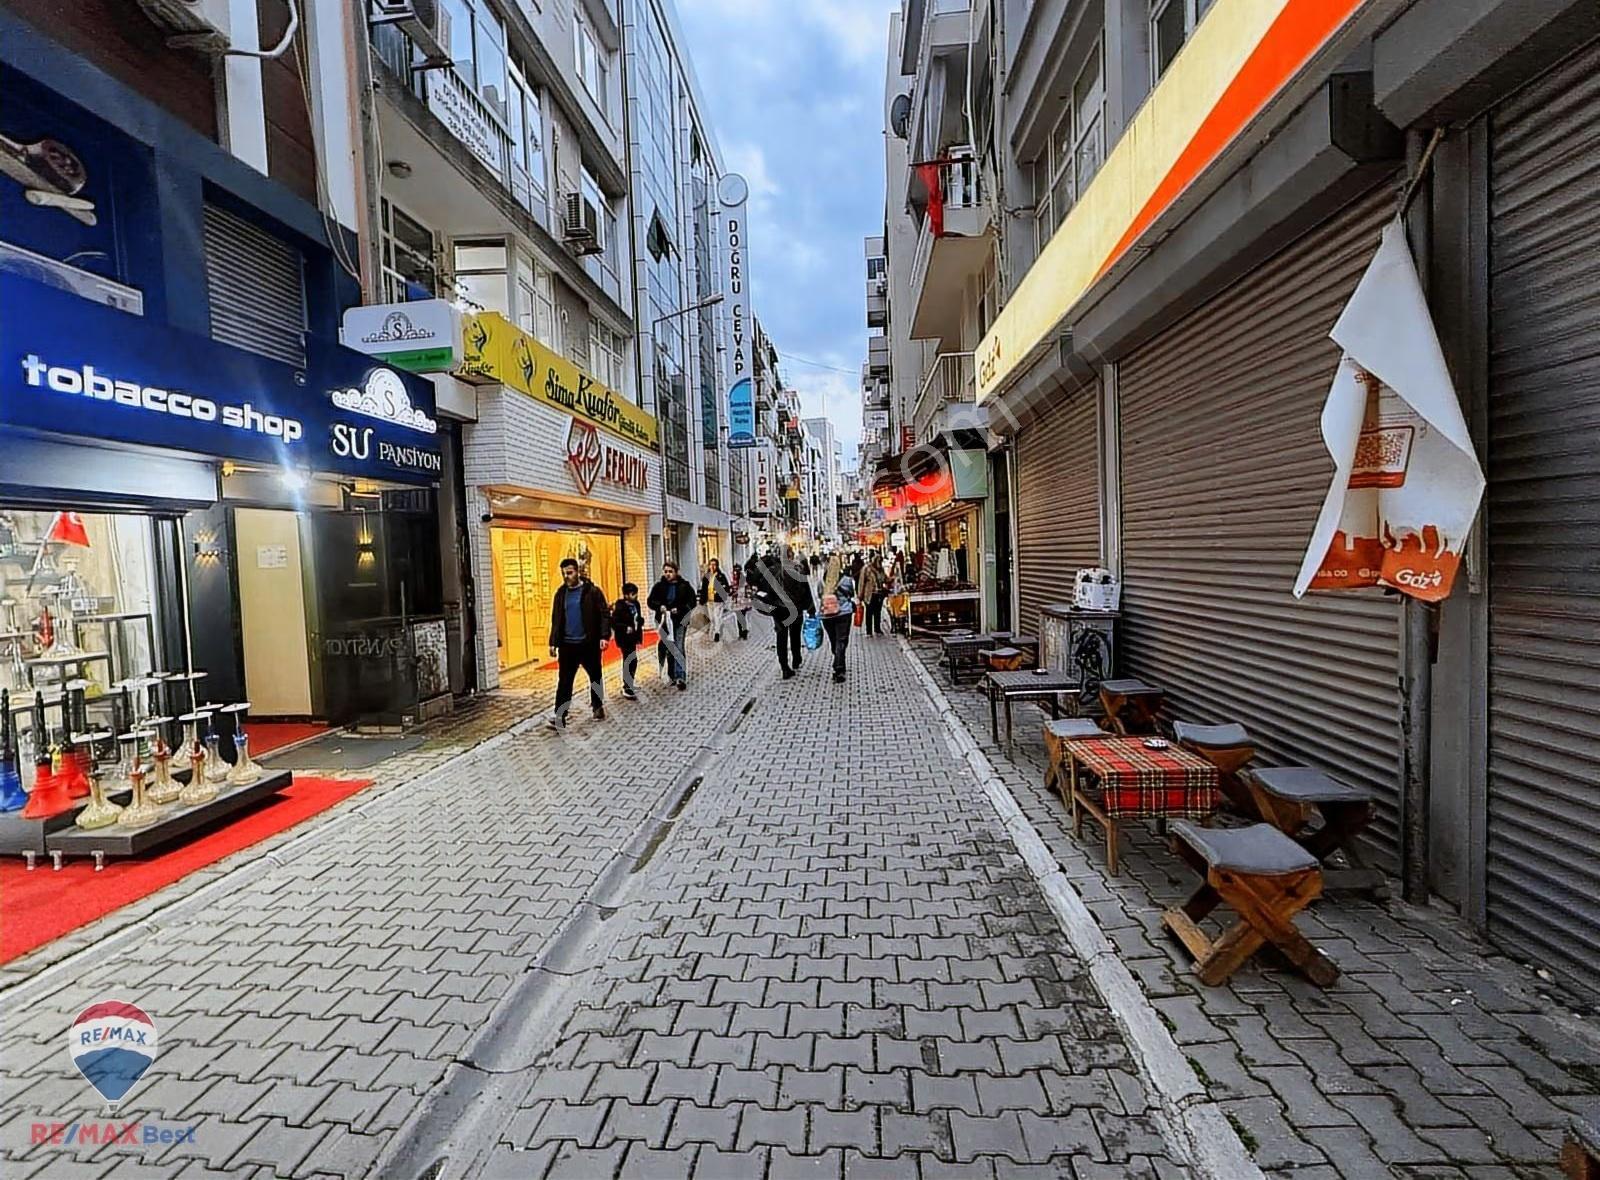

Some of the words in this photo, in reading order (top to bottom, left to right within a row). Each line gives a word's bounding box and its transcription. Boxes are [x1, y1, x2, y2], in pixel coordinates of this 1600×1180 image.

[728, 219, 741, 295] DOĞRU
[733, 303, 745, 376] CEVAP
[22, 353, 216, 423] tobacco
[223, 401, 303, 444] shop
[545, 367, 575, 411] Sima
[574, 373, 620, 424] Kuaför
[331, 424, 375, 460] SU
[379, 442, 441, 475] PANSİYON
